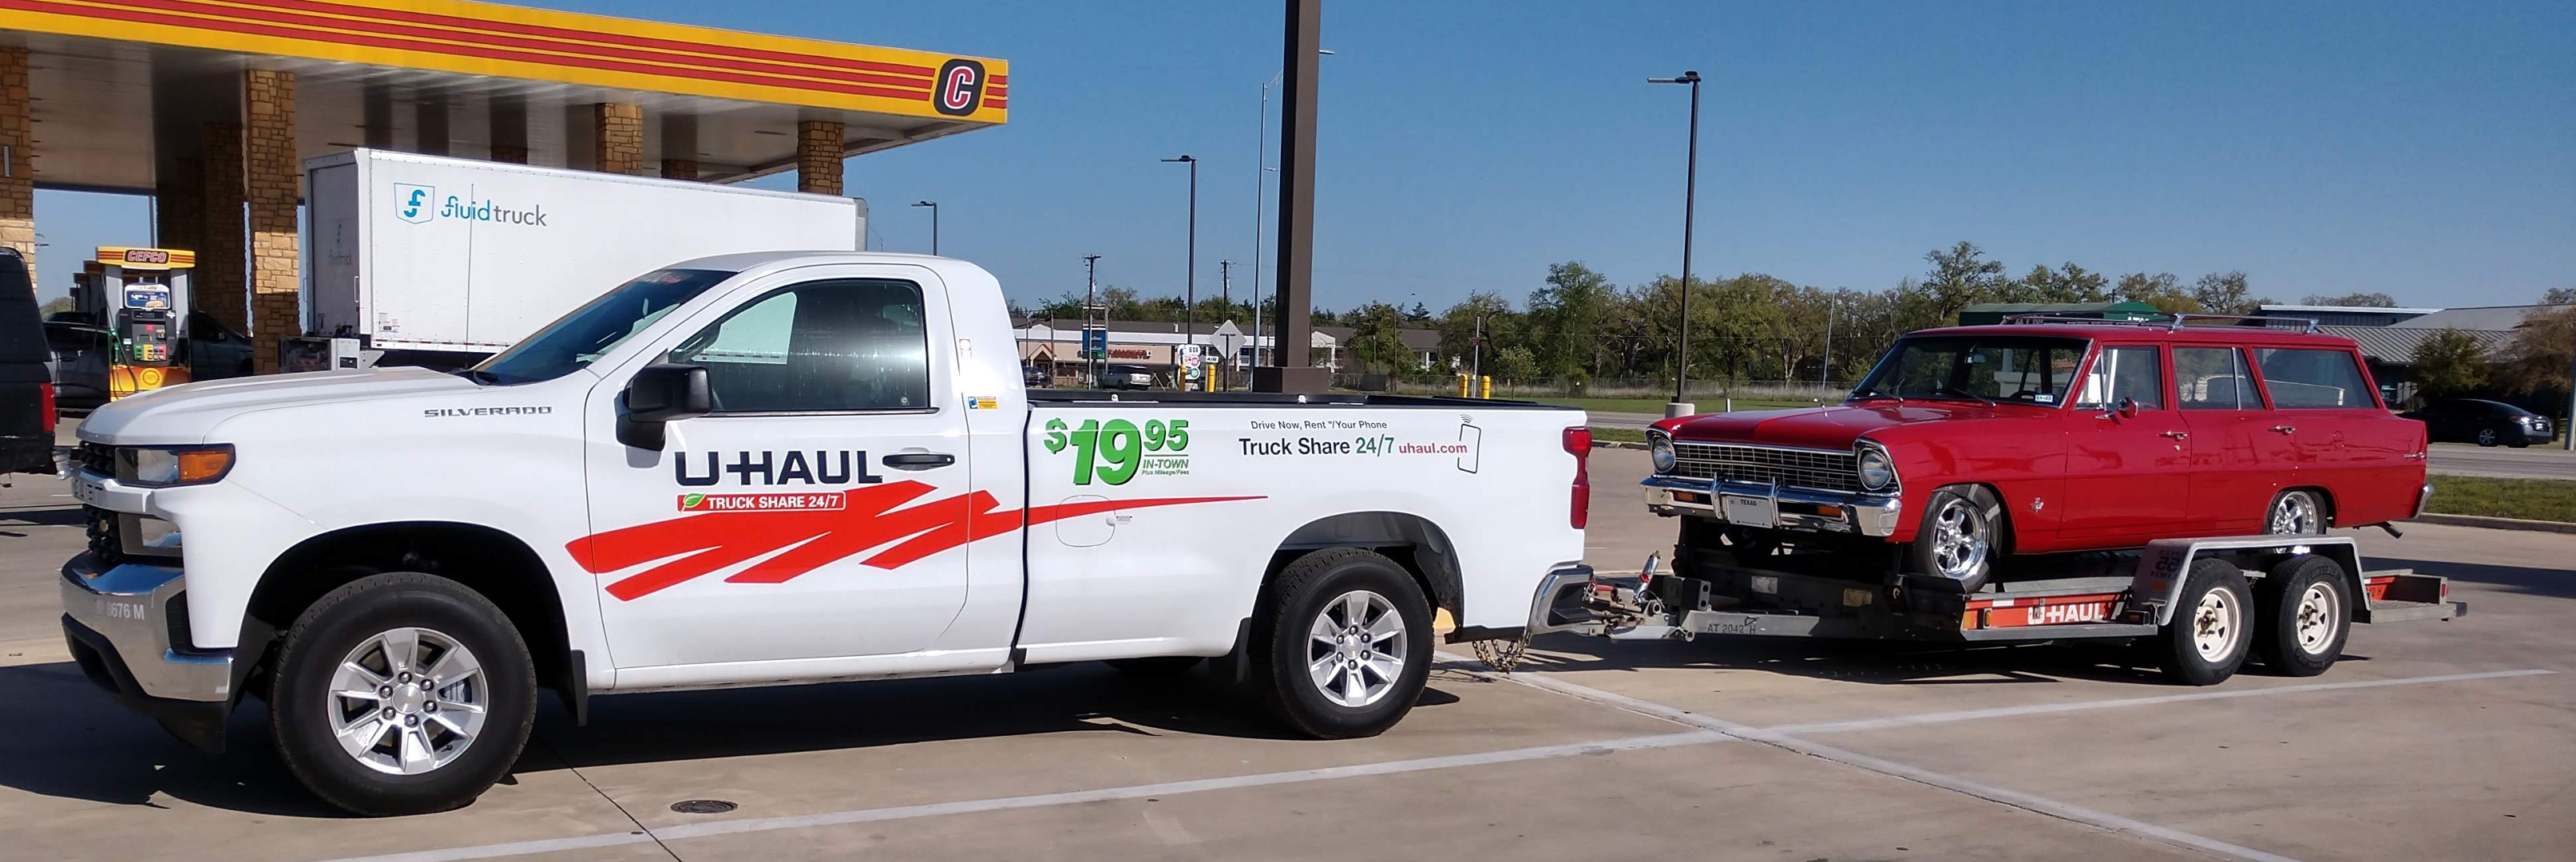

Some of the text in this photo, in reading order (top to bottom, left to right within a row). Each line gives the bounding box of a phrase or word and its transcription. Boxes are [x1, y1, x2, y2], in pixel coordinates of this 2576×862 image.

[944, 65, 975, 110] C
[441, 196, 547, 227] fluid truck
[127, 251, 167, 263] CEFCO
[424, 406, 553, 418] SILVERADO
[1250, 421, 1276, 429] Drive
[1278, 421, 1302, 430] Now,
[1238, 433, 1468, 457] Truck Share 24/7 uhaul.com
[675, 450, 882, 486] U-HAUL
[1143, 459, 1189, 469] IN-TOWN
[707, 494, 839, 509] TRUCK SHARE 24/7
[133, 603, 145, 619] M
[2027, 603, 2106, 625] U-HAUL
[1707, 624, 1756, 635] AT 2042 H
